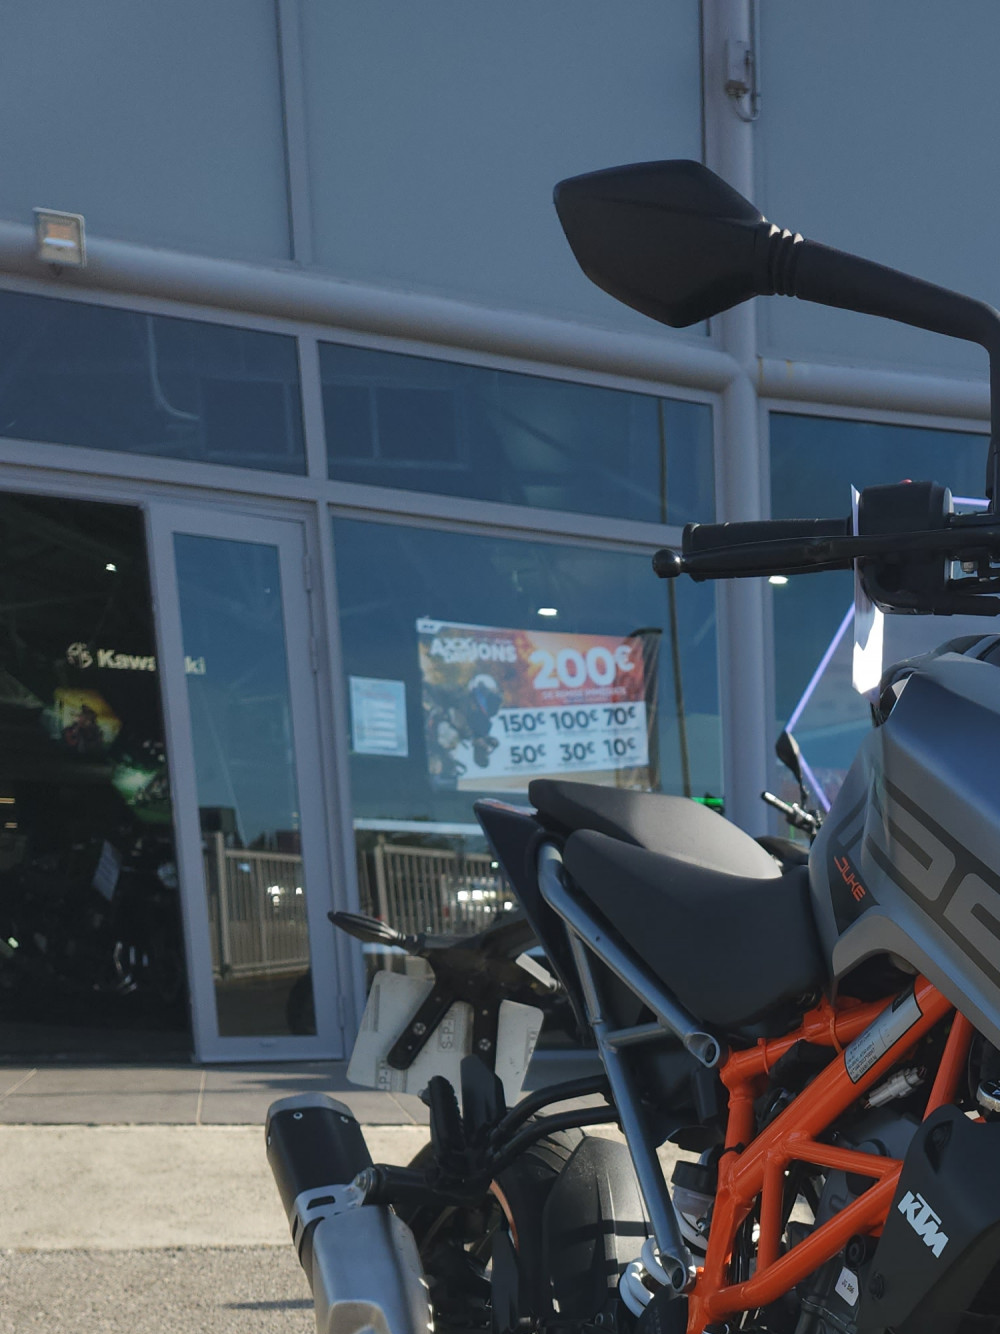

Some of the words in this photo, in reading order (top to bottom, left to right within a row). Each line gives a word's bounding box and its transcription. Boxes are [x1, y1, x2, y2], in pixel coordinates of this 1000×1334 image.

[97, 649, 207, 675] Kawaki
[527, 645, 635, 690] 200€
[498, 711, 546, 733] 150€
[550, 709, 598, 730] 100€
[602, 706, 636, 726] 70€
[509, 743, 546, 764] 50€
[559, 741, 596, 762] 30€
[603, 737, 637, 757] 10€
[833, 855, 866, 902] DUKE
[897, 1190, 949, 1259] KTM
